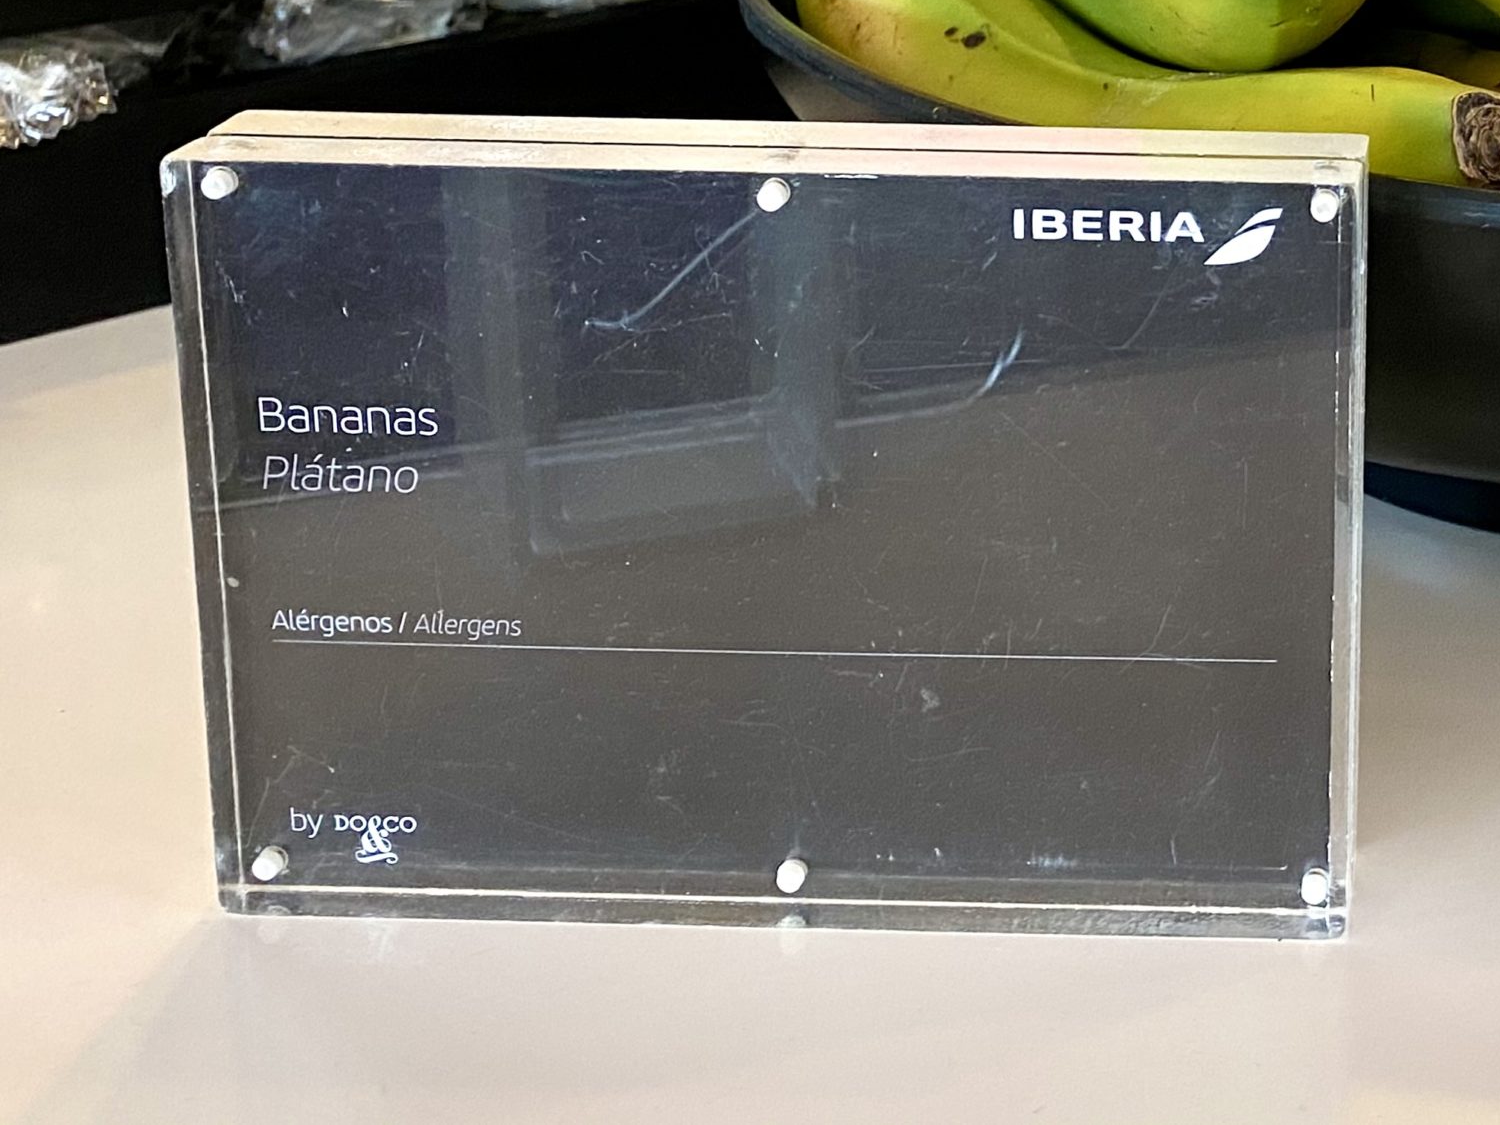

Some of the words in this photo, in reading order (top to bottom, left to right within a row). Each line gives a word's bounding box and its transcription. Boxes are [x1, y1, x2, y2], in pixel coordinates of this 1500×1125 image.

[1013, 208, 1205, 243] IBERIA
[257, 396, 439, 436] Bananas
[263, 453, 419, 494] Plátano
[272, 609, 393, 637] Alérgenos
[398, 611, 407, 634] /
[413, 612, 522, 641] Allergens
[290, 806, 324, 839] by
